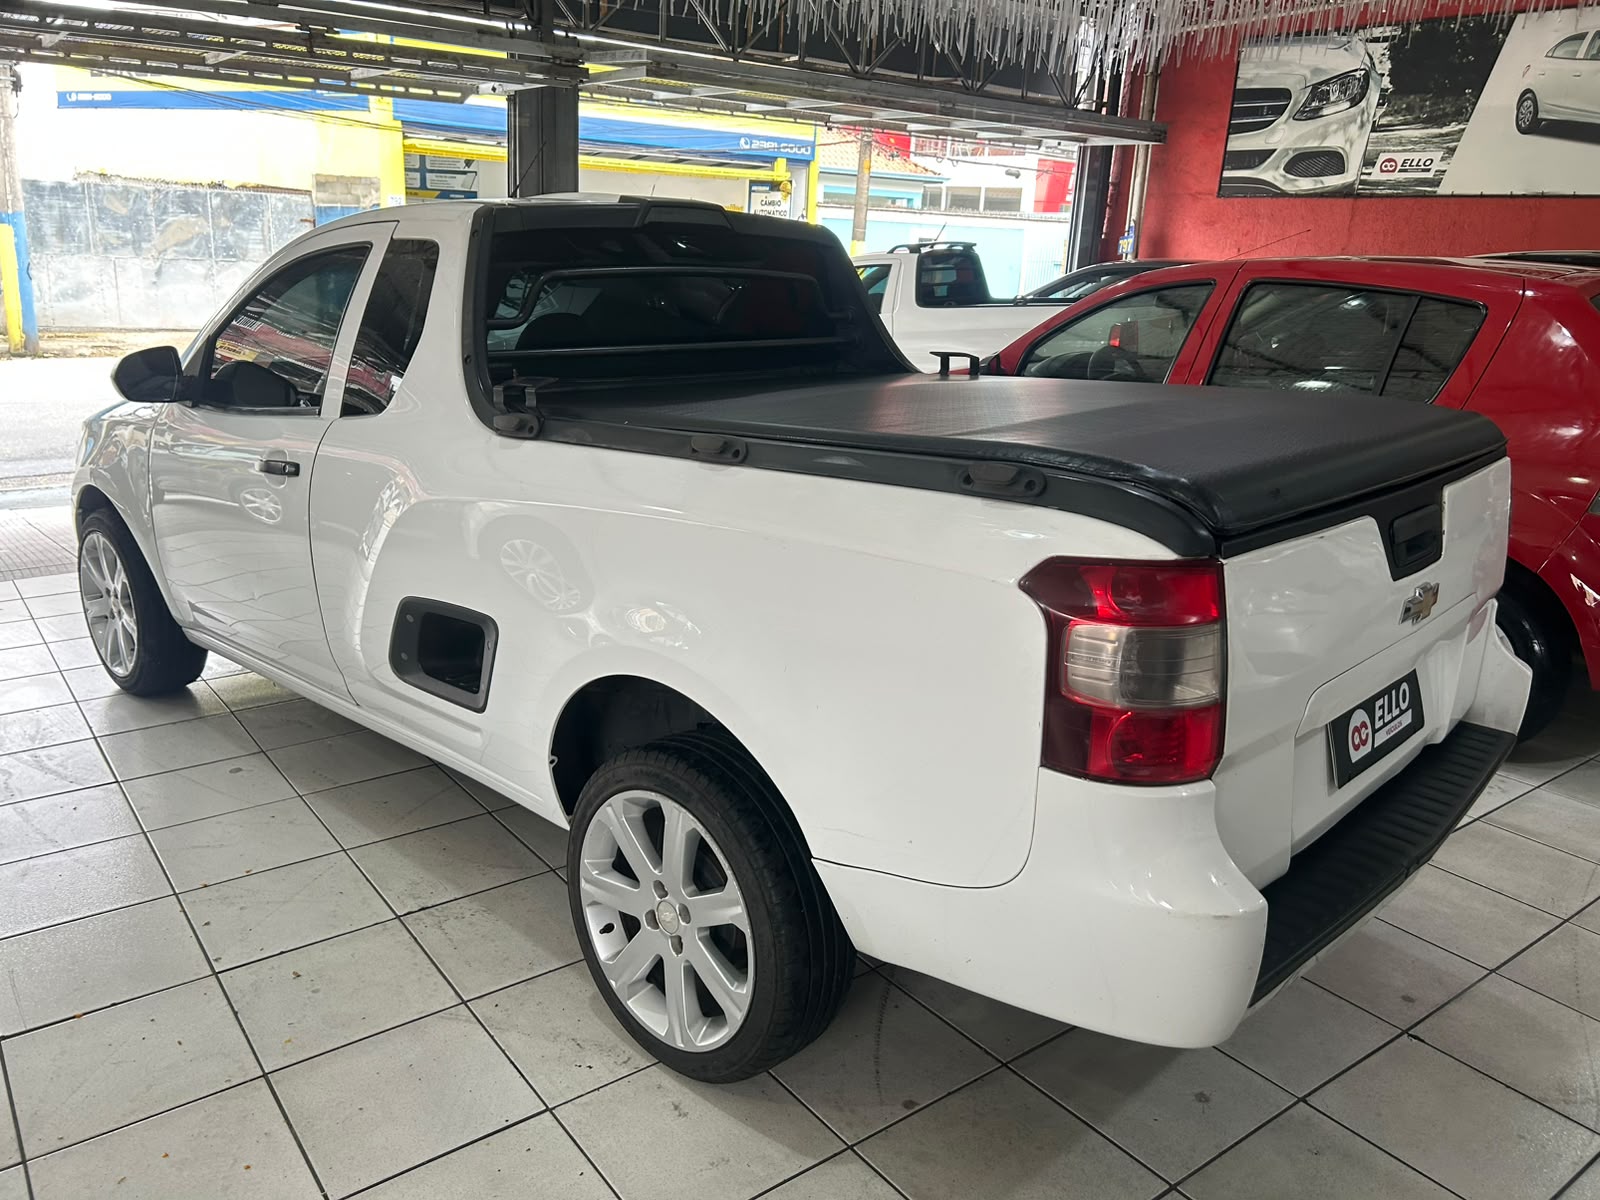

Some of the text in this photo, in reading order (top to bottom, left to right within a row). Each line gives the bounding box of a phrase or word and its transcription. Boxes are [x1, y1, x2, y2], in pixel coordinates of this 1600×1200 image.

[1400, 158, 1434, 168] ELLO
[1119, 238, 1133, 253] 797
[1374, 681, 1410, 730] ELLO
